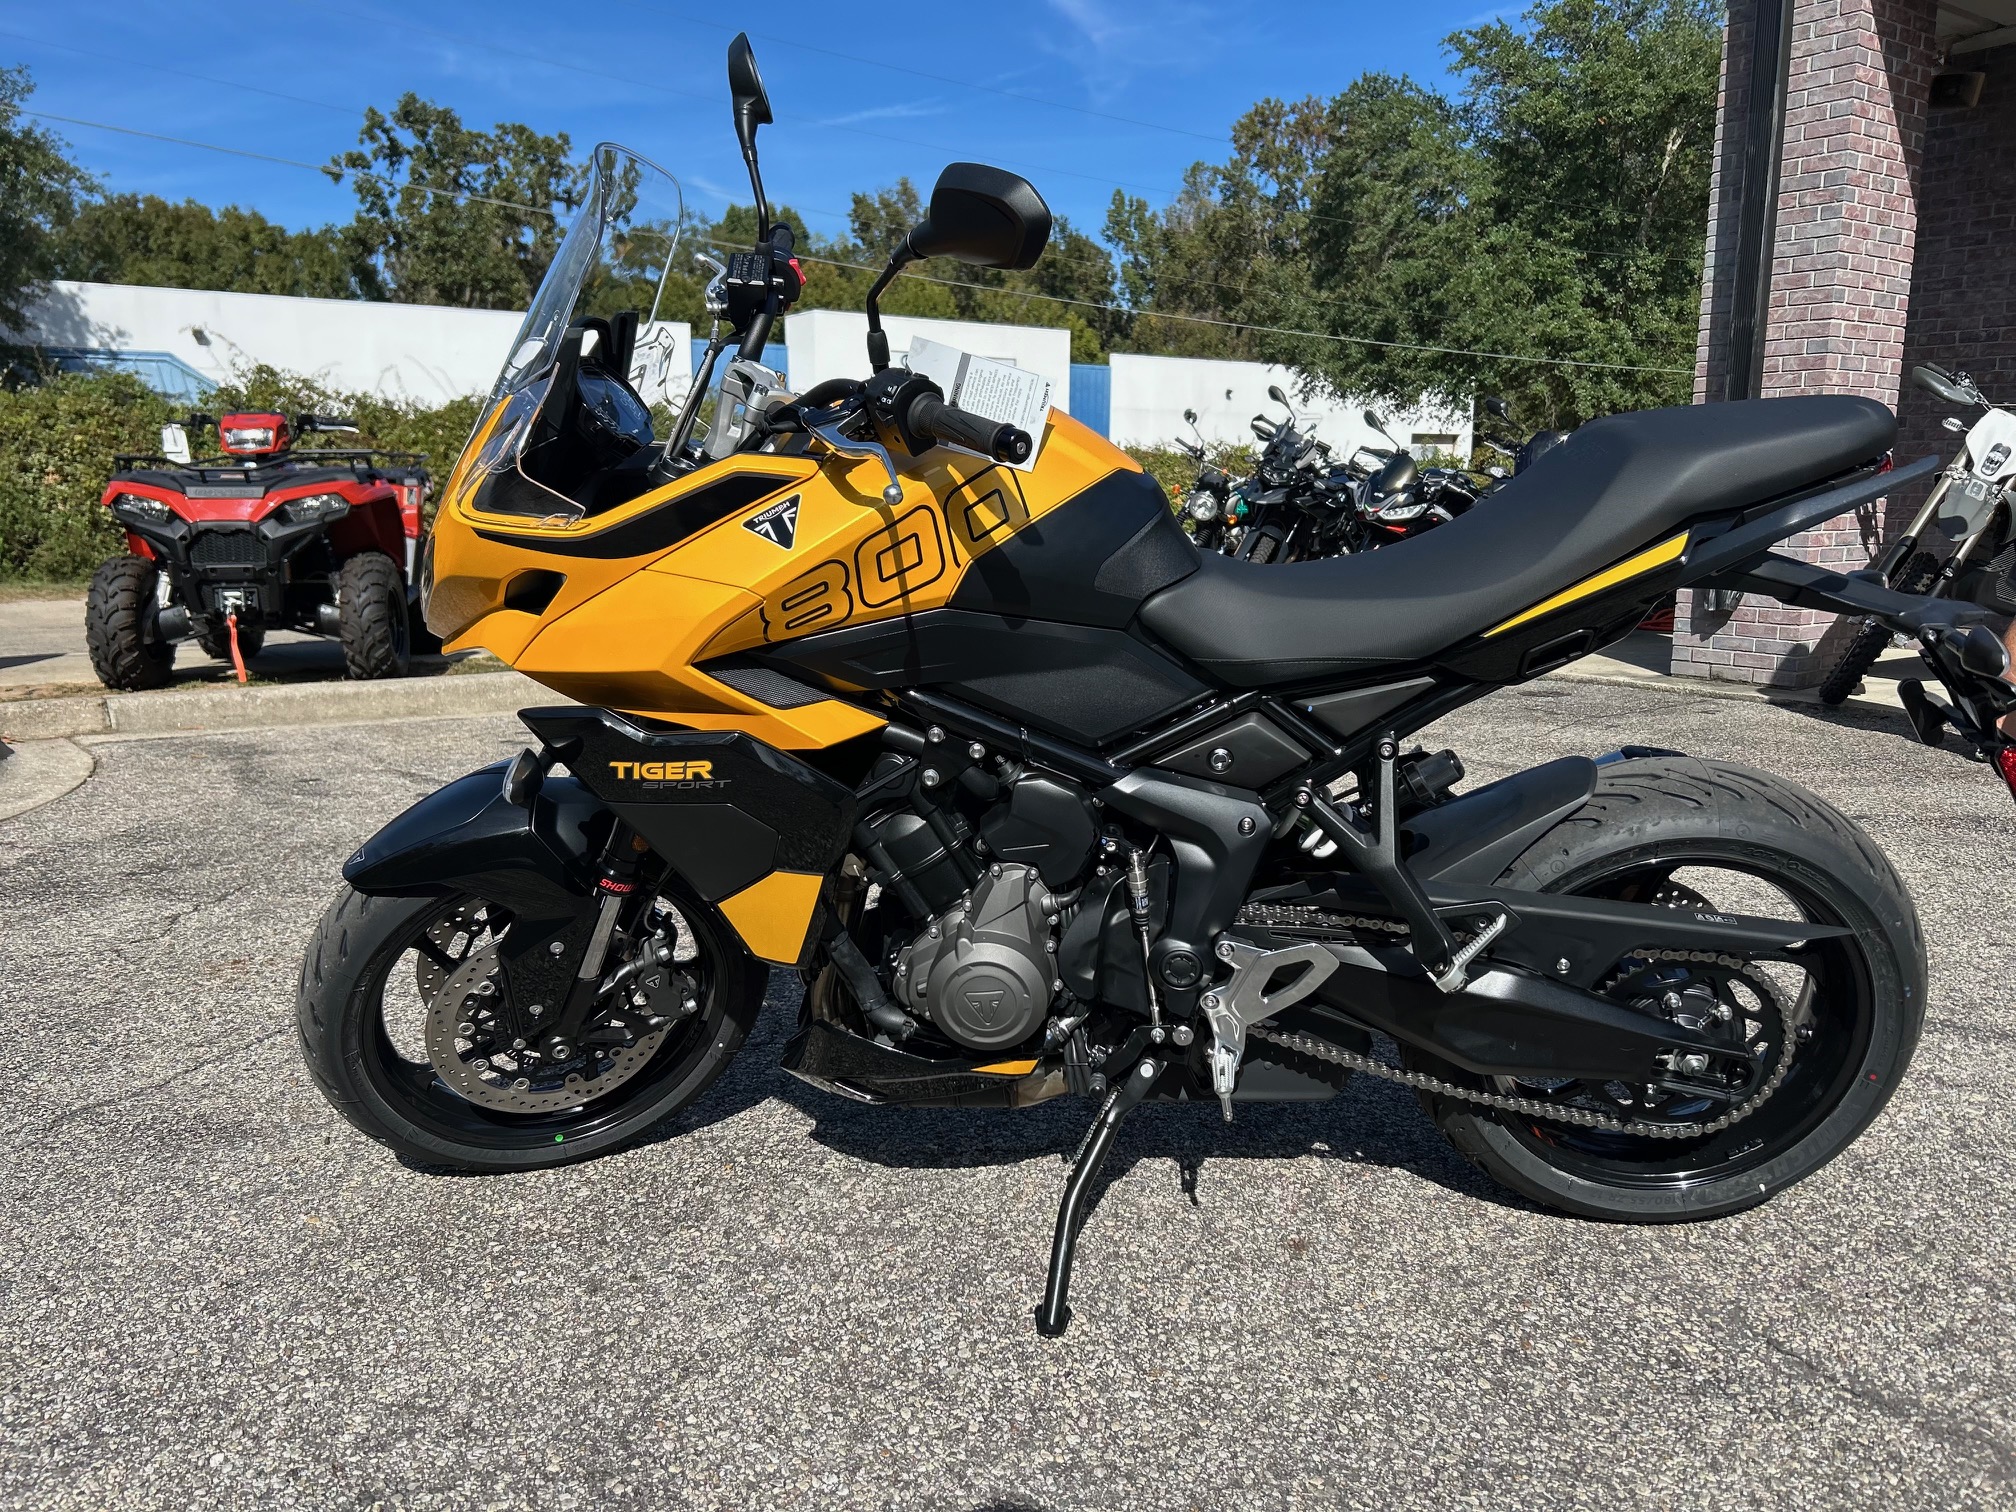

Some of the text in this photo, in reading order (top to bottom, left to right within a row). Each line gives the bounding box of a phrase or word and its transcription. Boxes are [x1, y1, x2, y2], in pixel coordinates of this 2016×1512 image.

[752, 500, 792, 524] TRIUMPH
[609, 760, 714, 780] TIGER
[641, 779, 732, 789] SPORT
